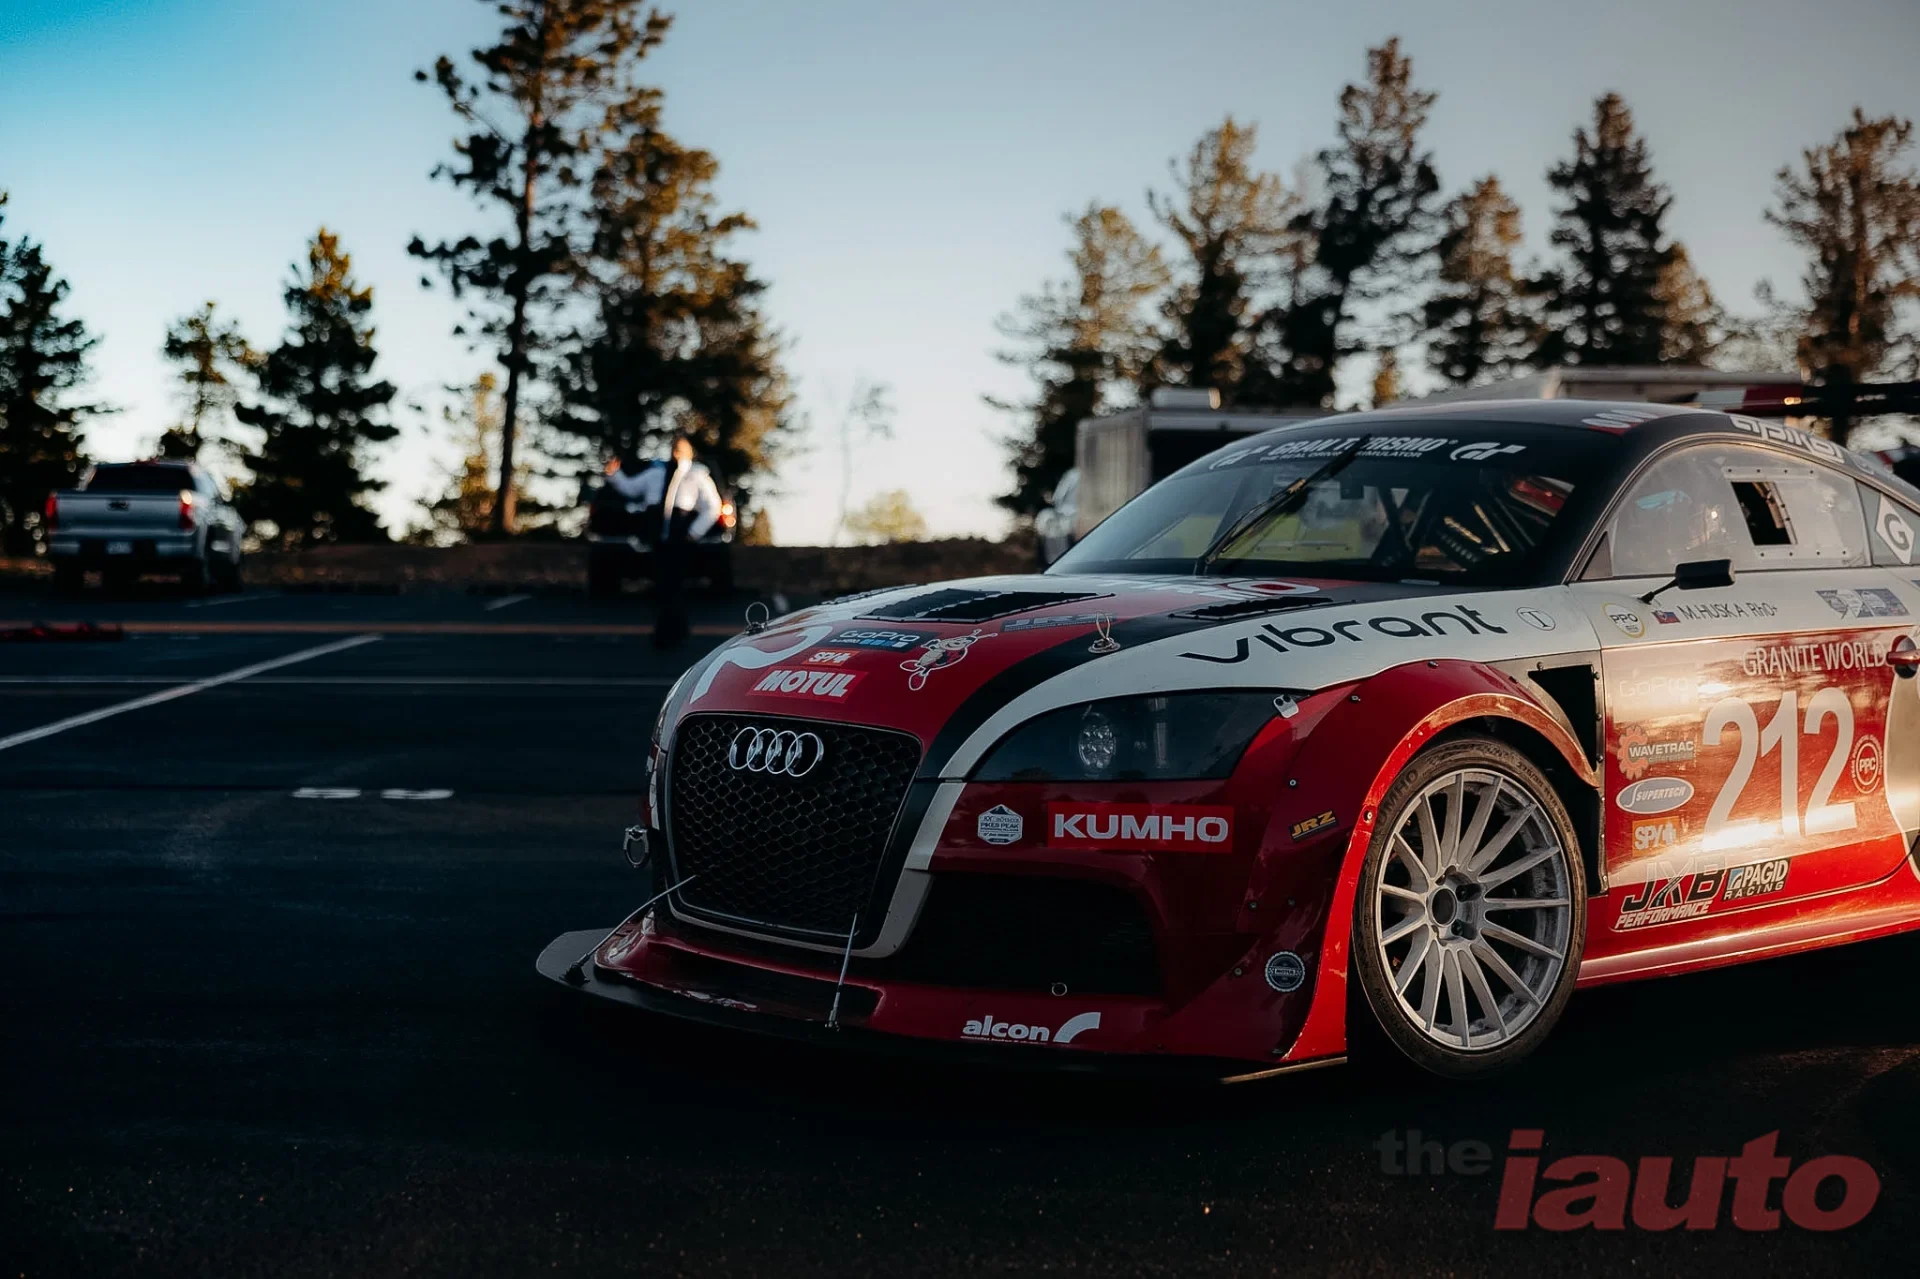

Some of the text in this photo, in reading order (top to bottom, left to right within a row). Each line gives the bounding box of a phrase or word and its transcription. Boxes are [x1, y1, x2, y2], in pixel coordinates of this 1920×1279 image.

[839, 630, 920, 642] GoPro
[1178, 604, 1508, 665] vibrant
[1742, 641, 1887, 677] GRANITE WORLD
[753, 670, 856, 698] MOTUL
[1628, 740, 1695, 758] WAVETRAC
[1702, 686, 1858, 851] 212
[1053, 813, 1229, 843] KUMHO
[1290, 810, 1337, 837] JRZ
[1634, 826, 1662, 850] SPY
[1741, 859, 1789, 889] PAGID
[1723, 880, 1784, 901] RACING
[1615, 900, 1713, 930] PERFORMANCE
[962, 1014, 1050, 1042] alcon
